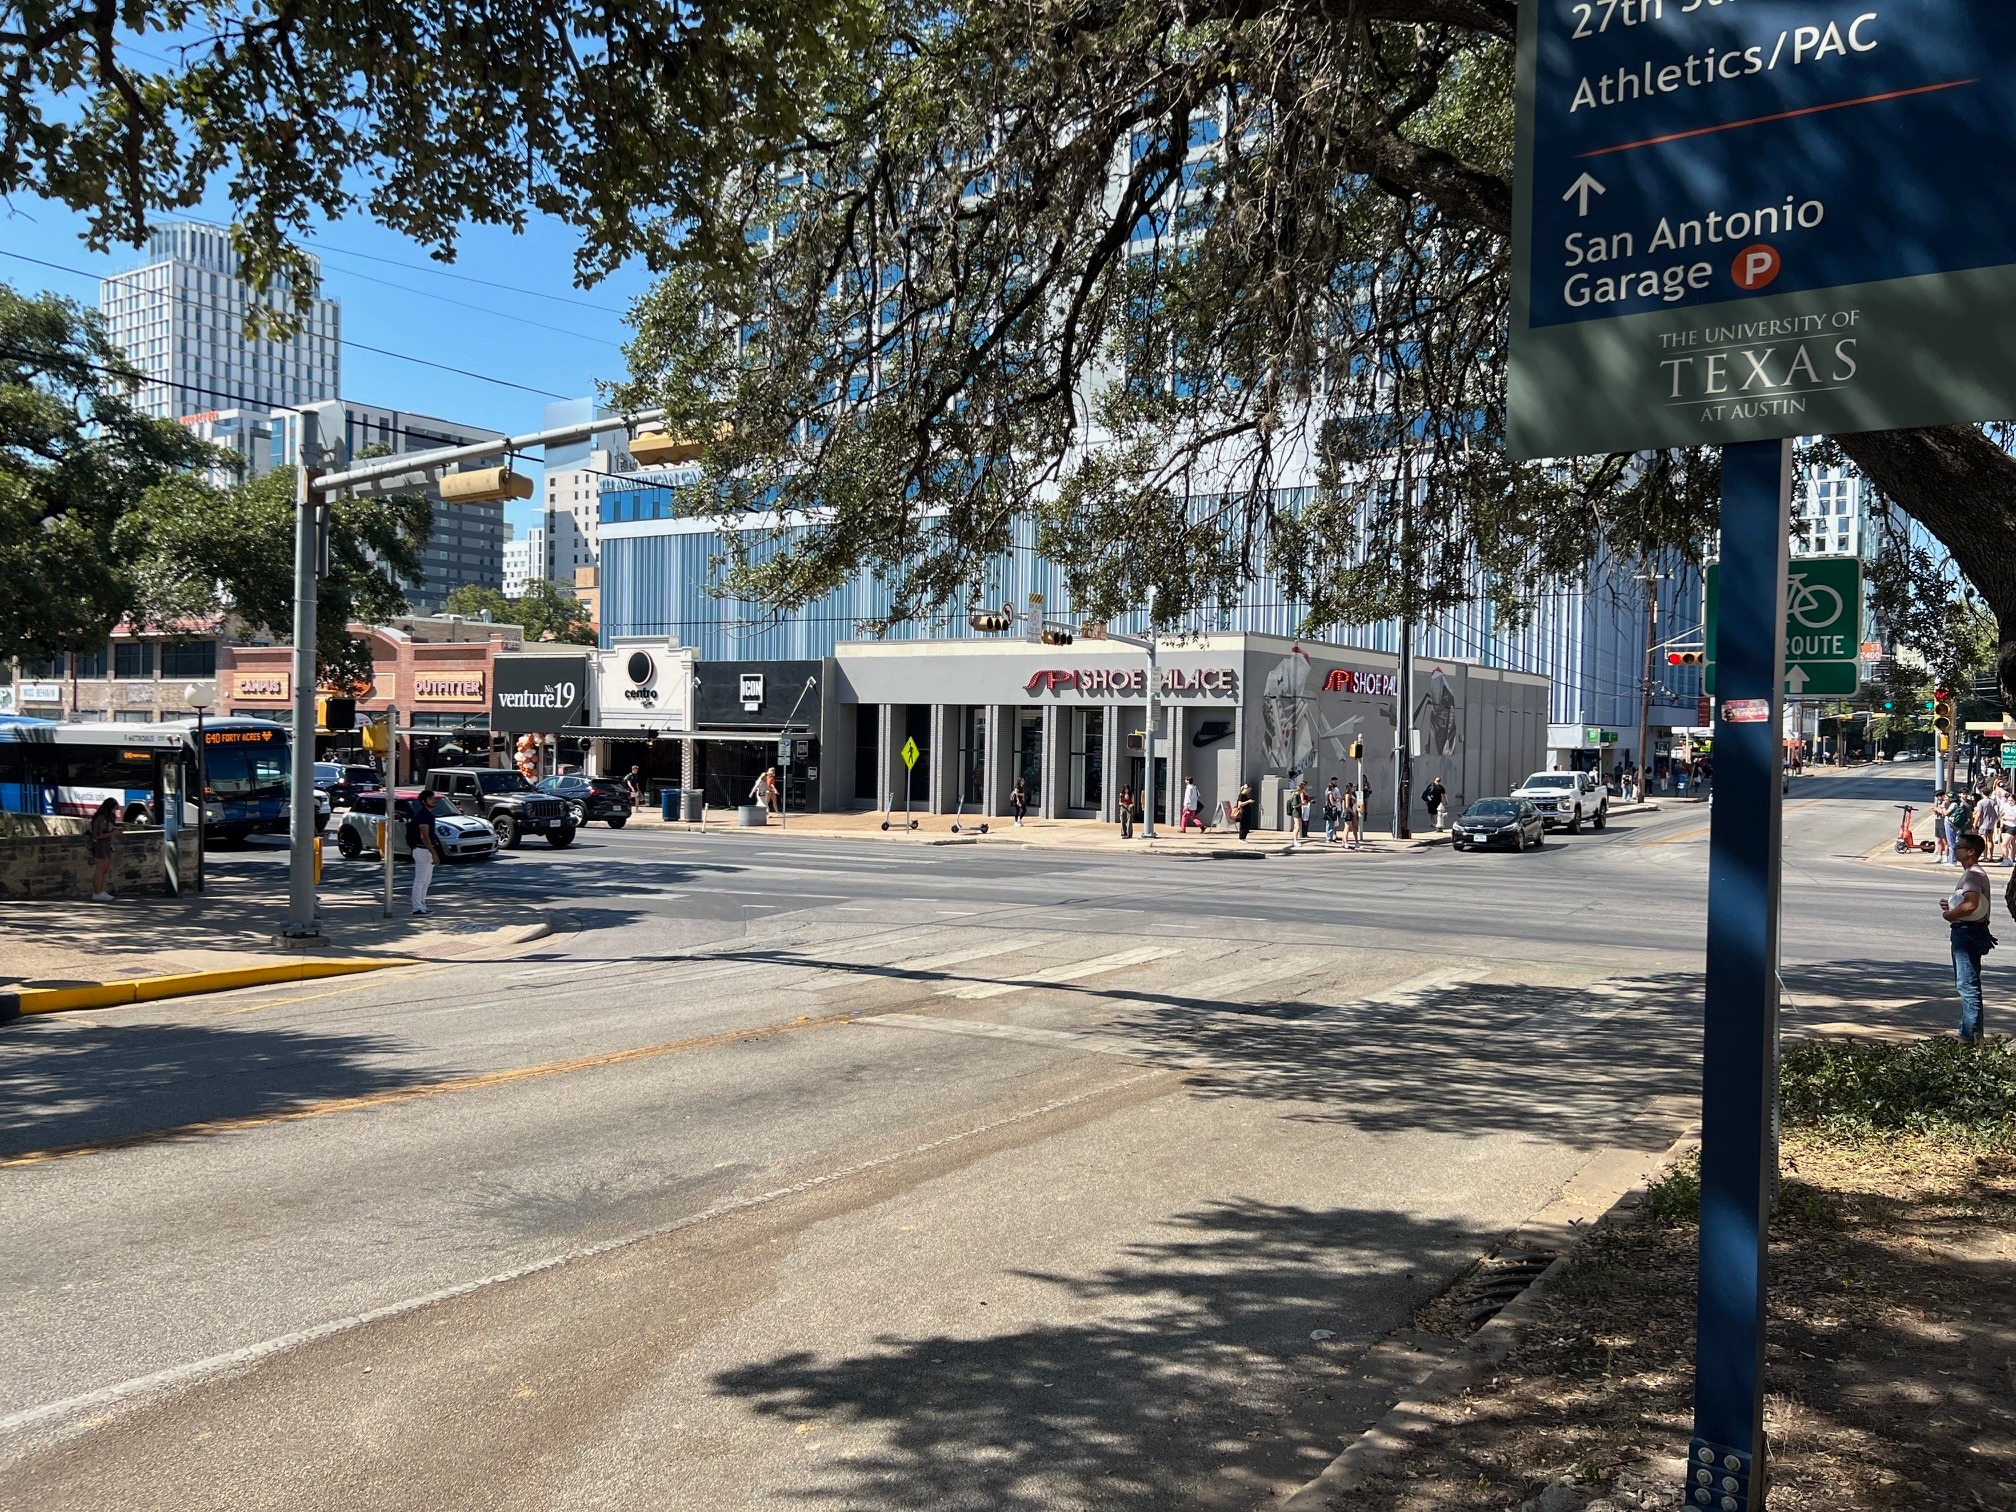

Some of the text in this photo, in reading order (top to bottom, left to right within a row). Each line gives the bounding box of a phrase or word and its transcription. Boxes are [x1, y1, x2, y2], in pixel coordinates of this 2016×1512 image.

[1571, 0, 1662, 39] 27th
[1569, 13, 1878, 113] Athletics/PAC
[1565, 195, 1824, 267] San Antonio
[1564, 261, 1713, 307] Garage
[1659, 310, 1860, 348] THE UNIVERSITY OF
[1659, 338, 1857, 398] TEXAS
[1701, 398, 1806, 422] AT AUSTIN
[1860, 651, 1880, 659] 2400
[241, 679, 281, 692] CAMPUS
[414, 679, 481, 693] OUTFITTER
[743, 680, 761, 696] ICON
[1080, 669, 1142, 690] SHOE
[1160, 669, 1233, 690] ALACE
[1353, 671, 1381, 695] SHOE
[498, 682, 575, 708] venture 19
[625, 687, 658, 699] centro
[205, 732, 261, 744] 640 FORTY ACRES
